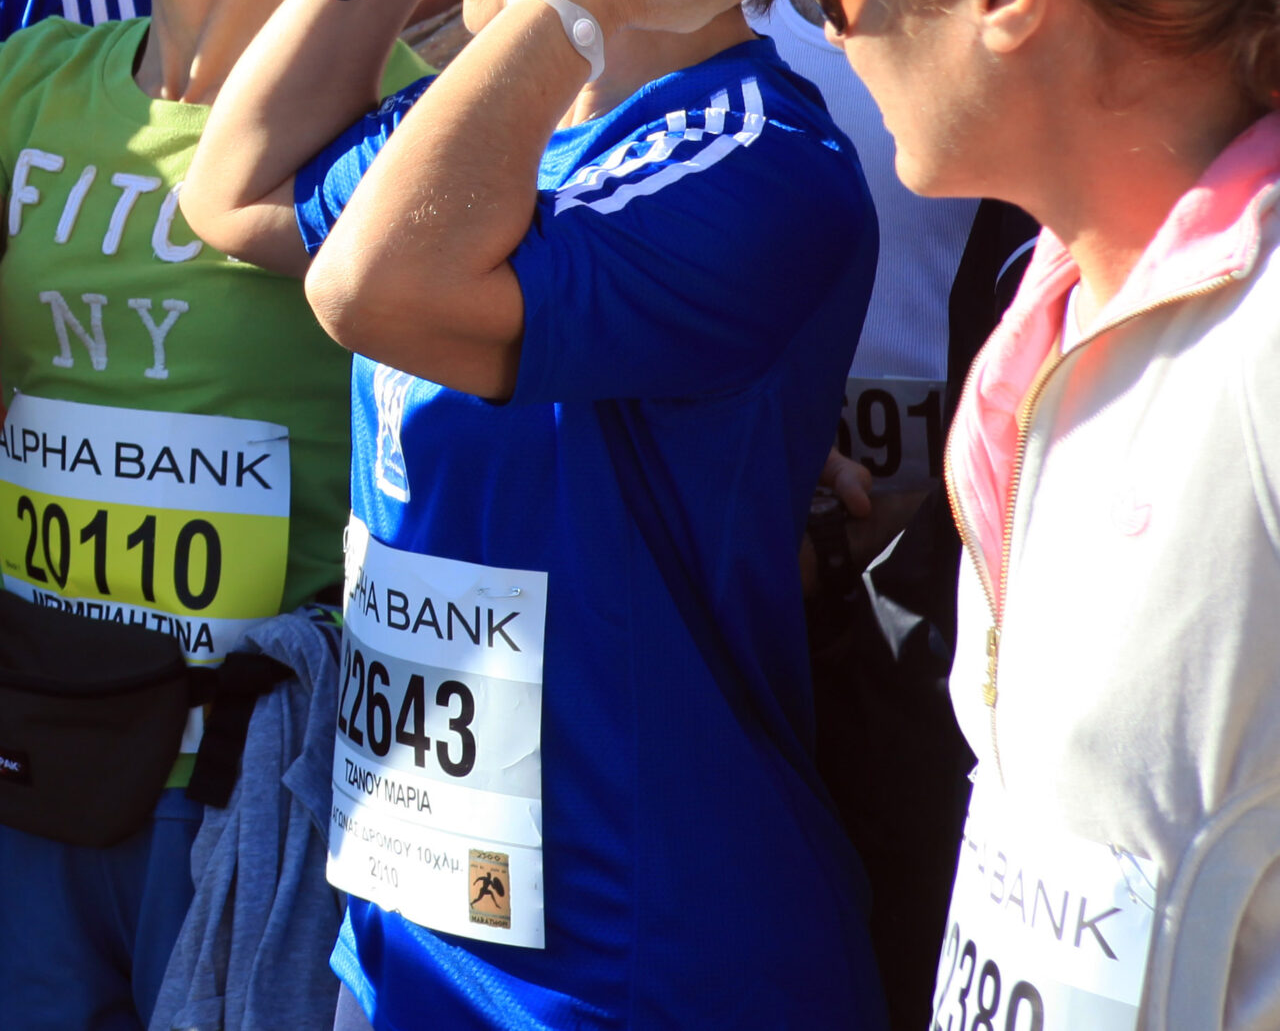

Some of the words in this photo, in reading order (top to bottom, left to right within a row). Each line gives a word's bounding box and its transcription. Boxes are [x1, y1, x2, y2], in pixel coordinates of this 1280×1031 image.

[9, 149, 238, 262] FITC
[39, 290, 190, 380] NY
[115, 442, 272, 490] BANK
[17, 495, 221, 610] 20110
[387, 588, 521, 652] BANK
[338, 640, 476, 778] 22643
[345, 758, 382, 799] ΤΖΑΝΟΥ
[384, 779, 432, 815] ΜΑΡΙΑ
[989, 850, 1123, 961] BANK
